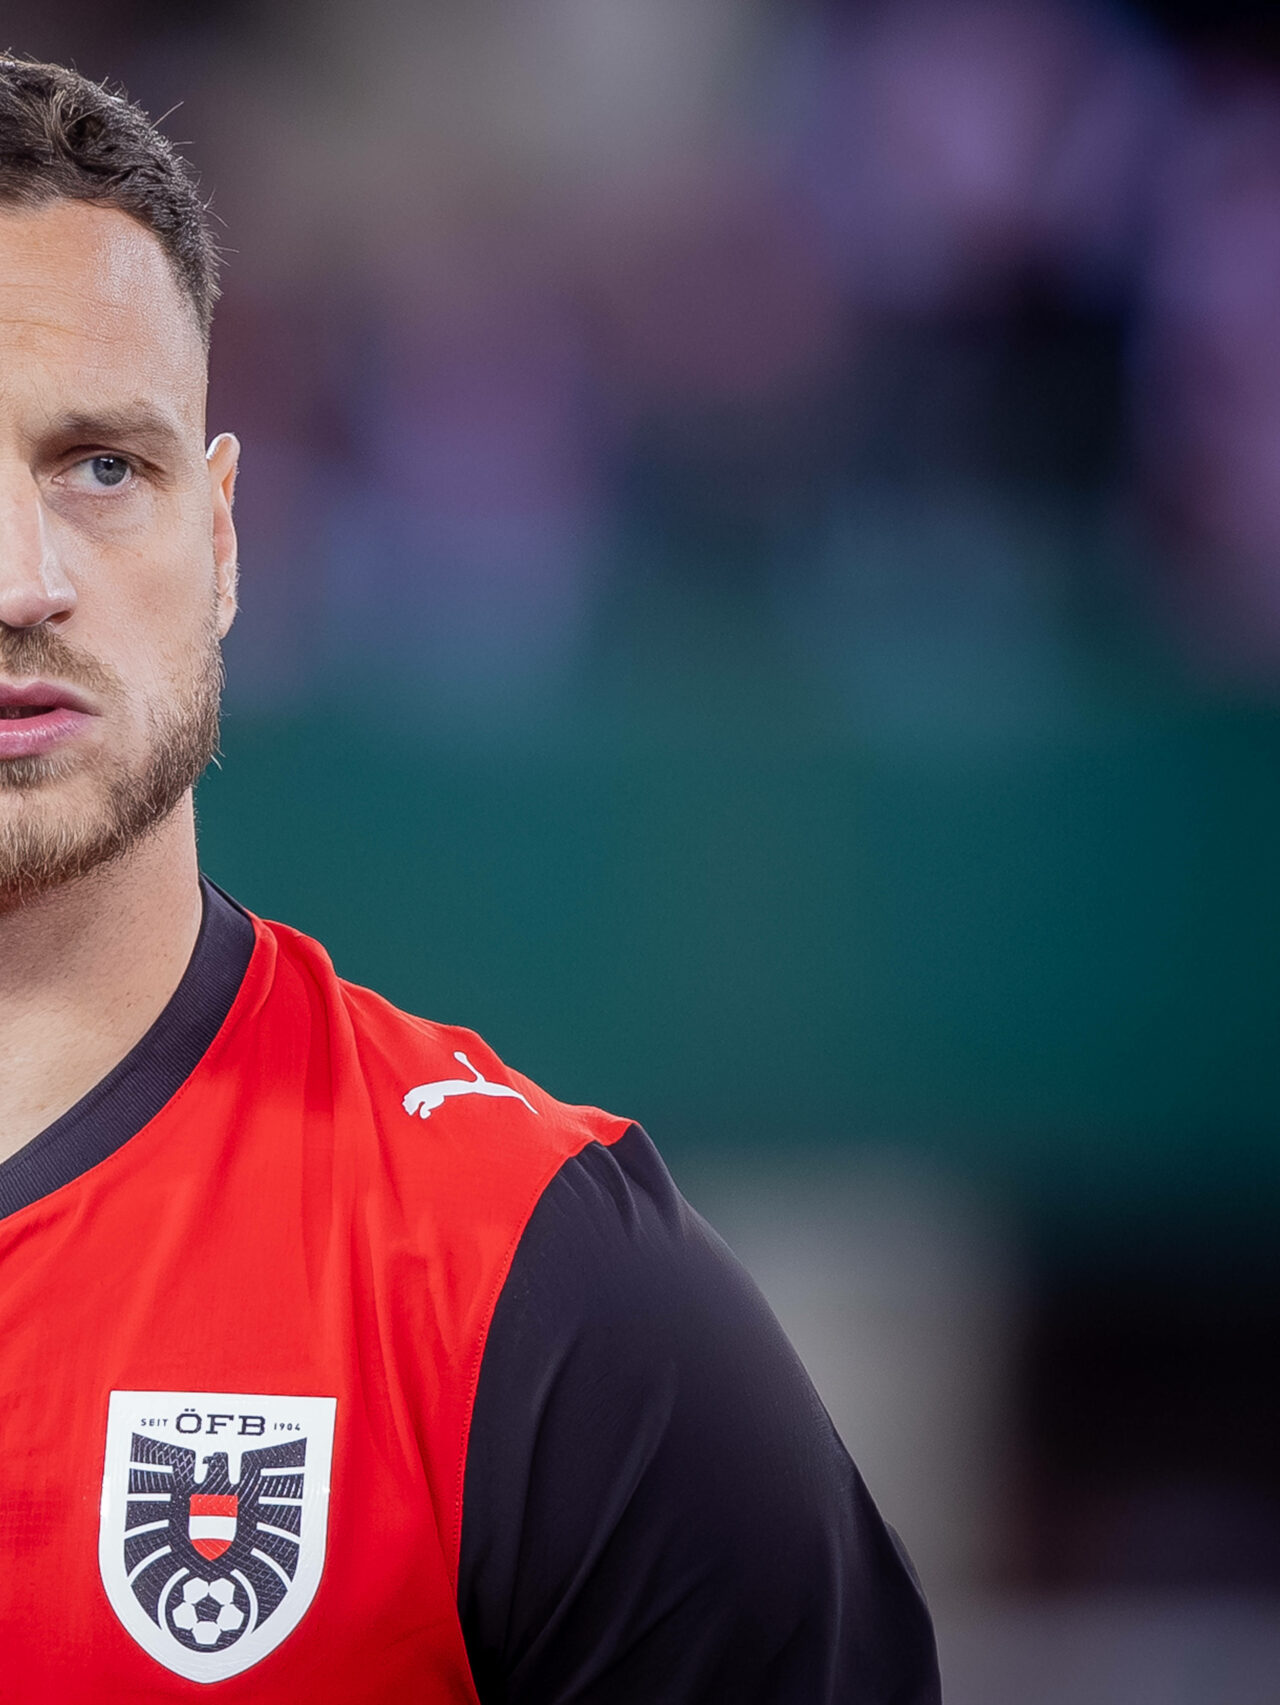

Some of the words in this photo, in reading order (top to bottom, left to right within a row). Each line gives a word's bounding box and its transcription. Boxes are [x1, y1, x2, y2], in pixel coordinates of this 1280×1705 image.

[141, 1418, 168, 1427] SEIT
[176, 1408, 265, 1436] ÖFB
[273, 1422, 301, 1431] 1904
